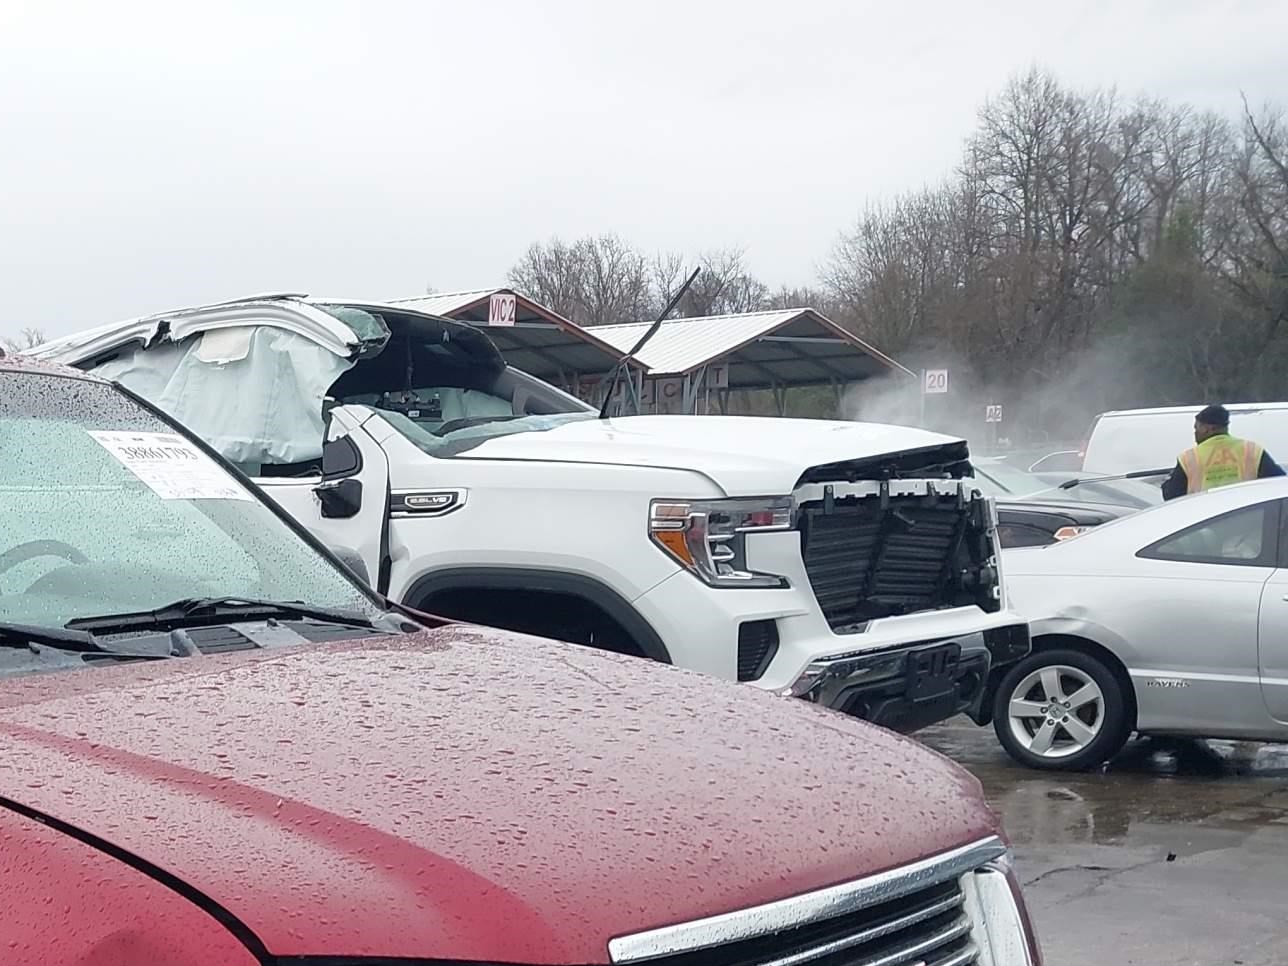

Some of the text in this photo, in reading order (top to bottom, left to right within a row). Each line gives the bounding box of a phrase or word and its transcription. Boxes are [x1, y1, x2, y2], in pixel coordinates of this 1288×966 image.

[492, 298, 514, 321] VIC 2
[927, 374, 945, 389] 20
[118, 447, 198, 460] 38861793
